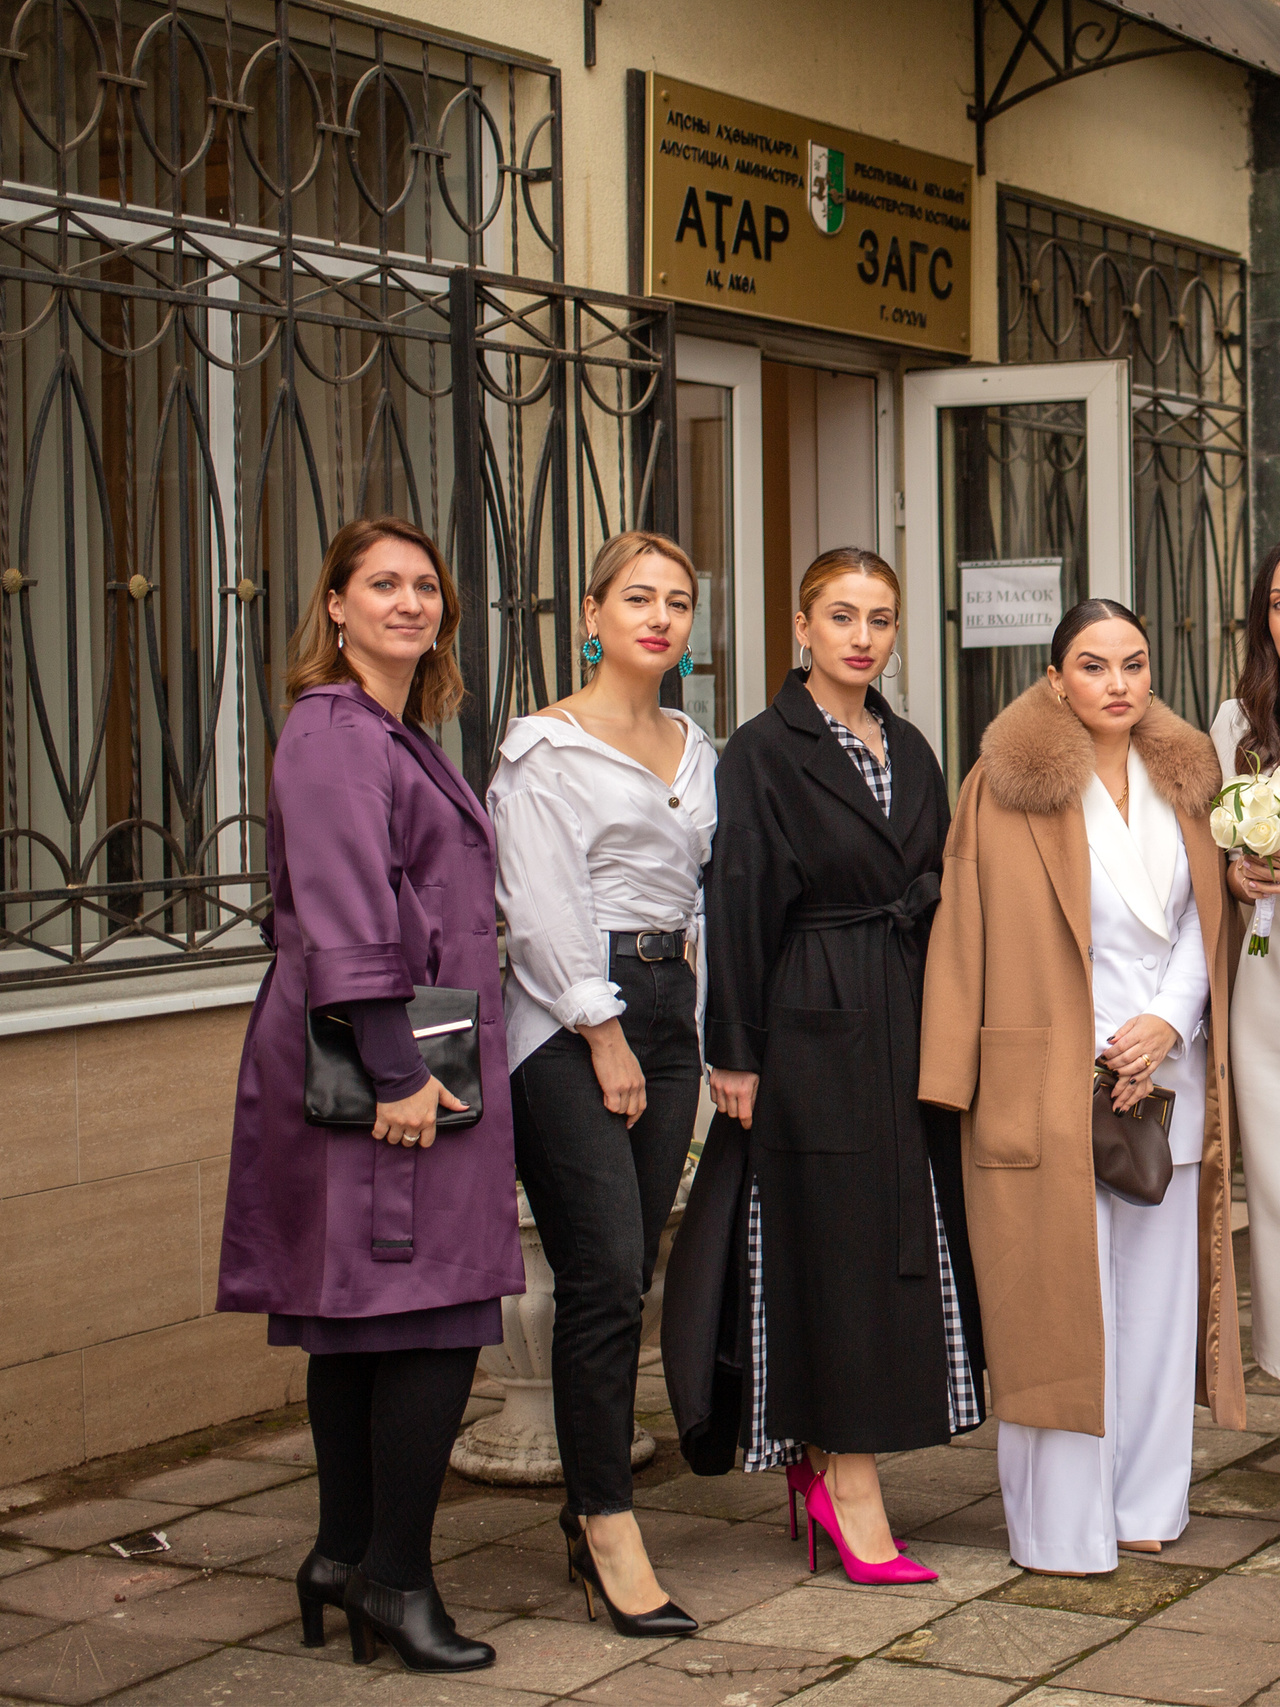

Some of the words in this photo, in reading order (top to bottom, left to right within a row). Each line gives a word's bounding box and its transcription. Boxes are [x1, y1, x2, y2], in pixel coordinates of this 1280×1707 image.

[857, 228, 953, 301] ЗАГС
[966, 590, 992, 604] БЕЗ
[997, 589, 1053, 604] МАСОК
[966, 614, 985, 627] НЕ
[988, 612, 1053, 627] ВХОДИТЬ
